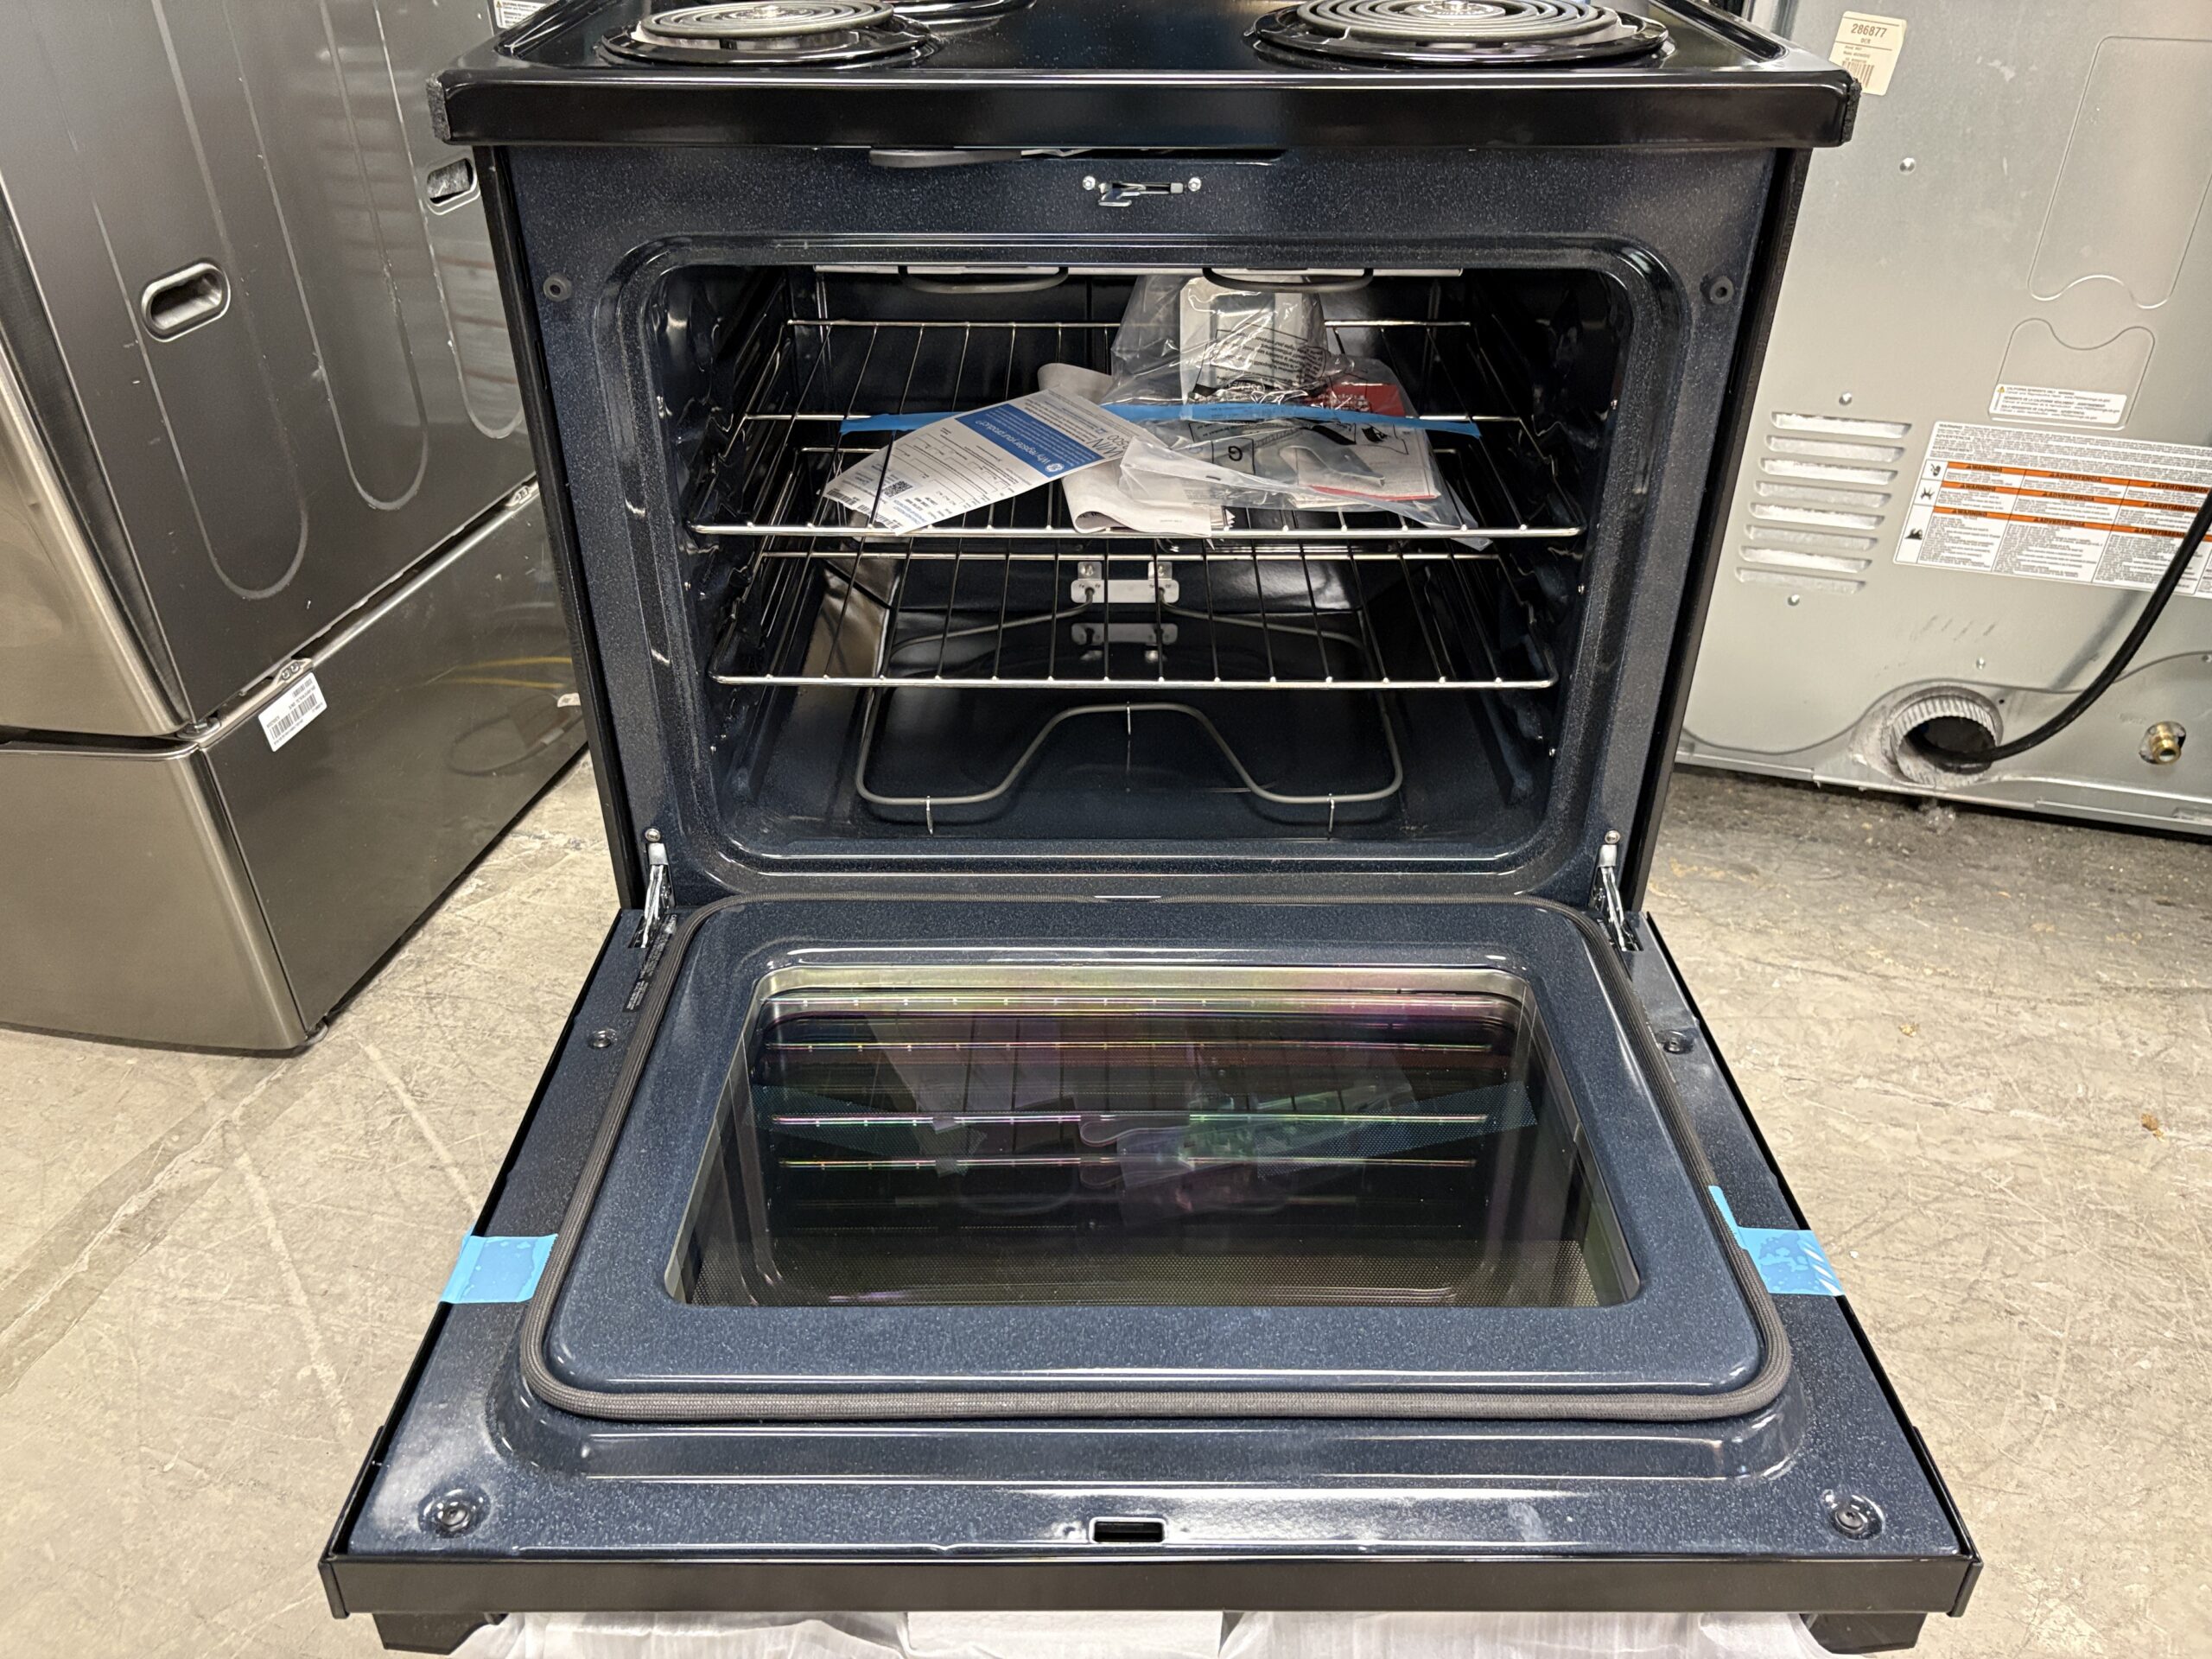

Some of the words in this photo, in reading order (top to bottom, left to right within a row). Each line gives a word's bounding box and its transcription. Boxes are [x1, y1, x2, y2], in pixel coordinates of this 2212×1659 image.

[1851, 23, 1887, 37] 286877
[1014, 441, 1037, 456] register
[1228, 446, 1243, 462] G
[1036, 453, 1052, 465] Why
